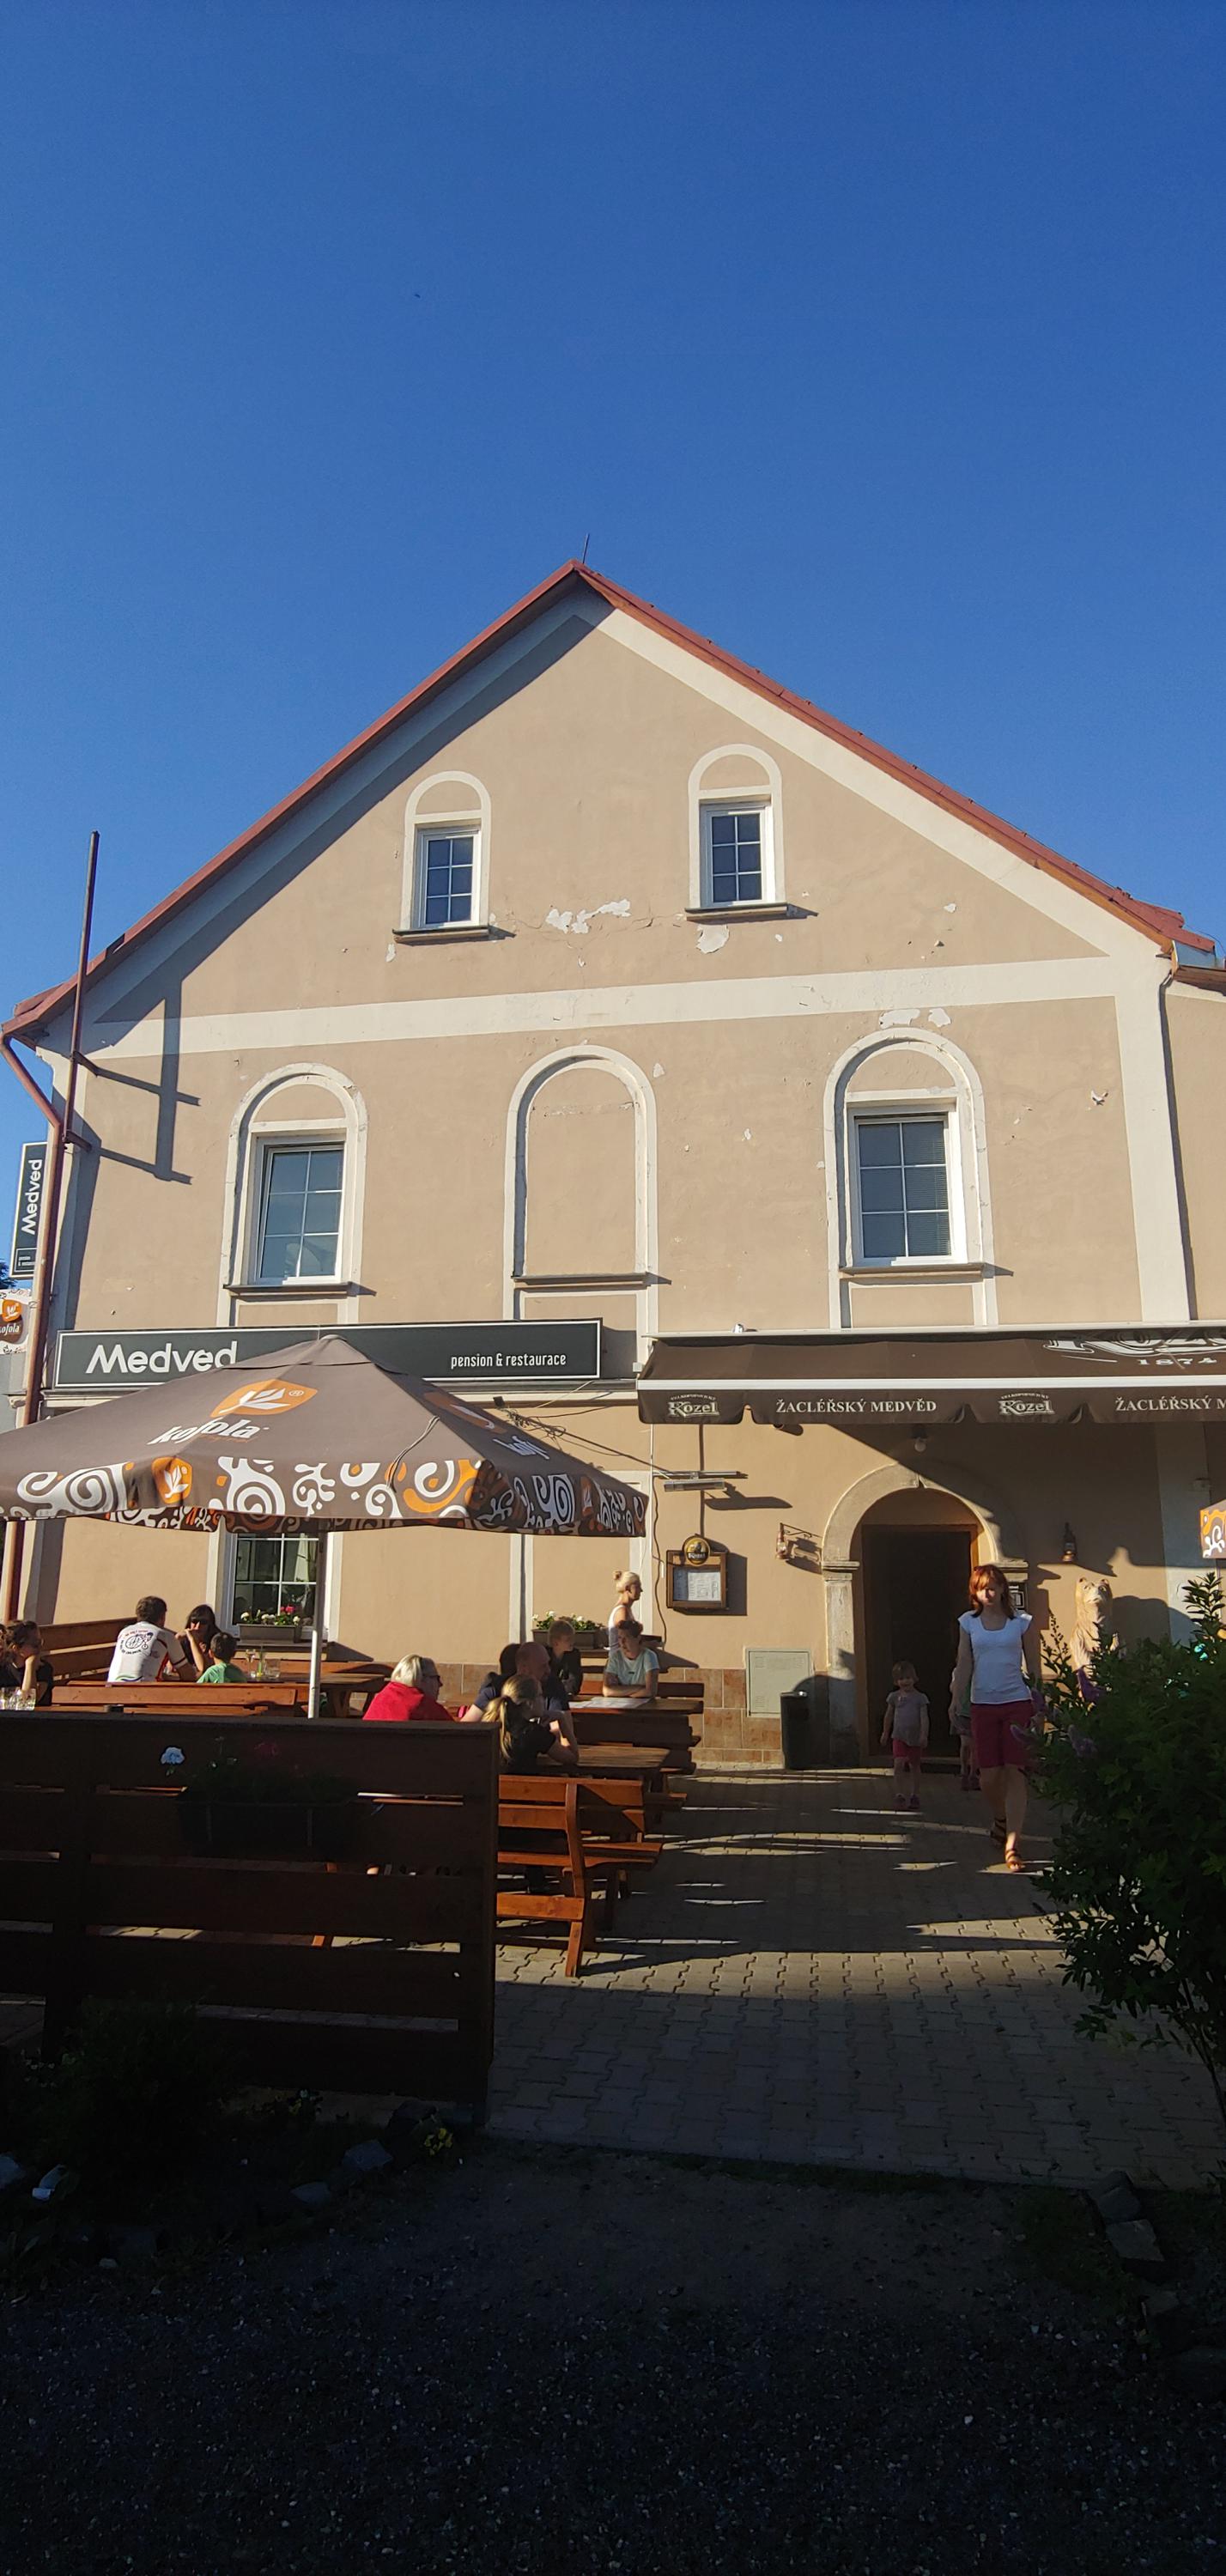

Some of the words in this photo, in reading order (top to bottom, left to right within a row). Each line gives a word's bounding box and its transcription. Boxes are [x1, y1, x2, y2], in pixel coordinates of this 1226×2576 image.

[0, 1323, 20, 1336] ofola
[451, 1353, 493, 1370] pension
[495, 1352, 503, 1367] &
[506, 1353, 567, 1367] restaurace
[1137, 1357, 1217, 1365] 1874
[667, 1400, 720, 1418] Kozel
[775, 1398, 867, 1413] ŽACLÉŘSKÝ
[871, 1397, 937, 1413] MEDVĚD
[998, 1400, 1056, 1416] Kozel
[1115, 1394, 1212, 1411] ŽACLÉŘSKÝ
[146, 1416, 260, 1445] kofola
